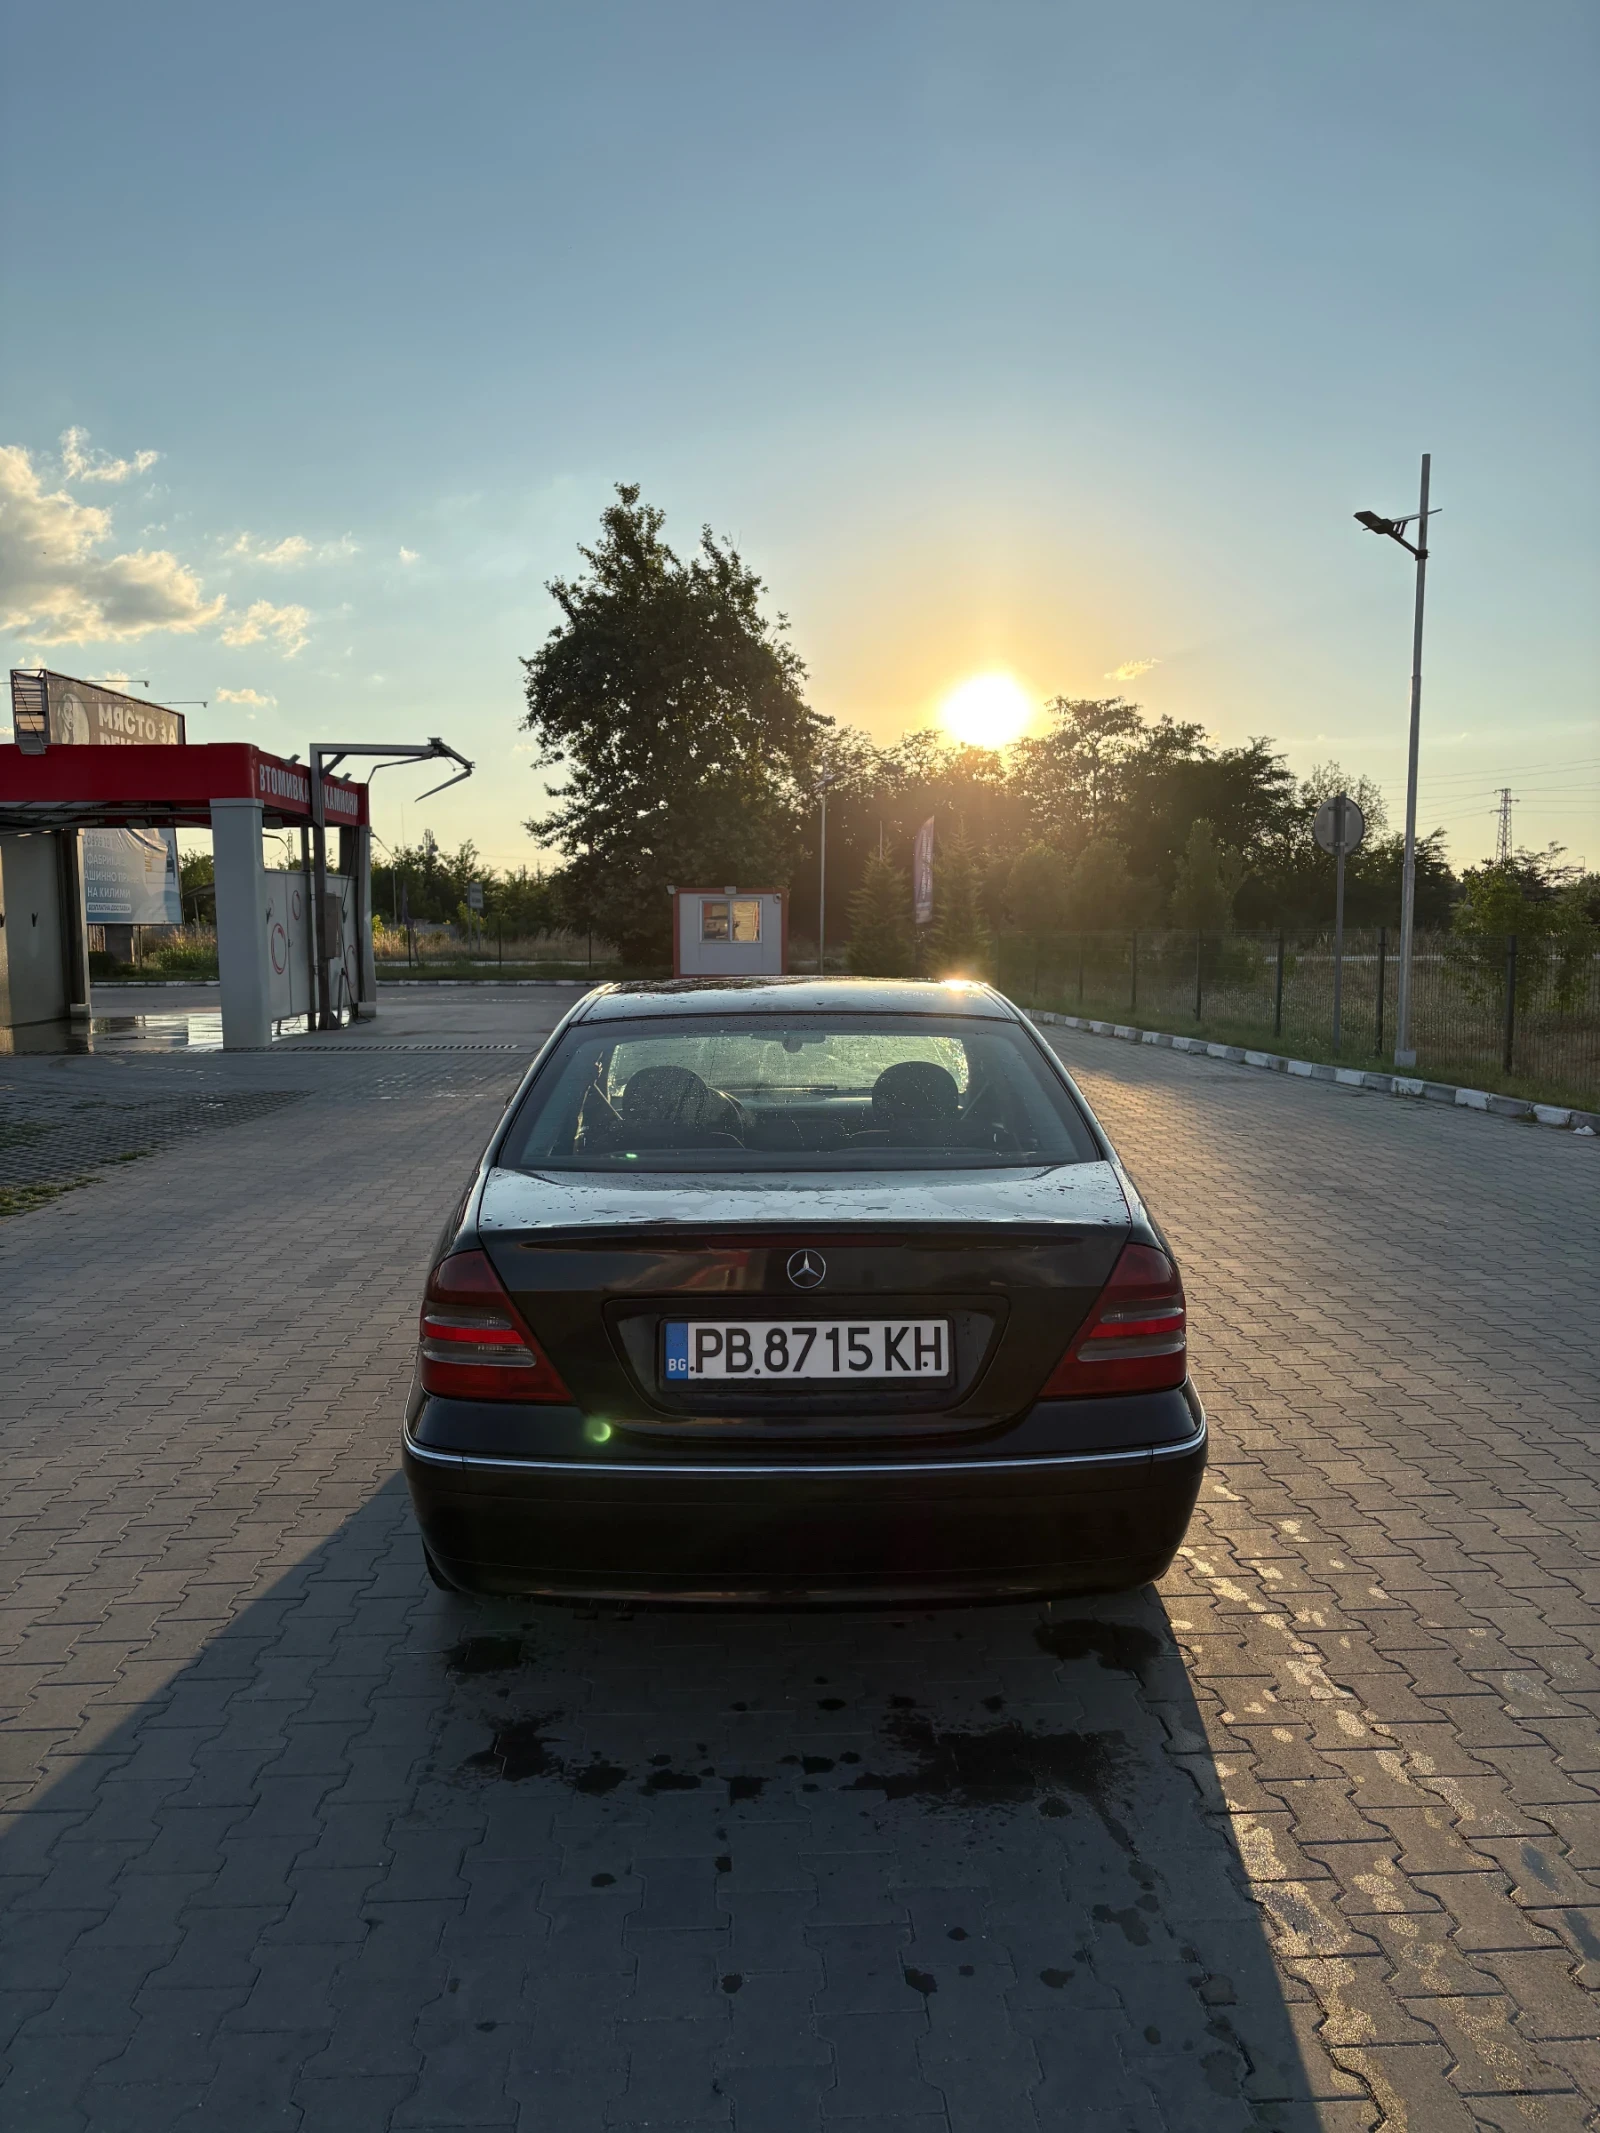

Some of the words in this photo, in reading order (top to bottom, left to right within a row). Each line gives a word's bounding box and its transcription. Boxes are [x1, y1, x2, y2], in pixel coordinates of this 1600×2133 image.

[98, 703, 156, 740] МЯСТО
[159, 721, 177, 745] ЗА
[324, 784, 358, 815] КАМИОНИ
[87, 886, 98, 897] НА
[100, 887, 131, 898] КИЛИМИ
[668, 1358, 687, 1371] BG
